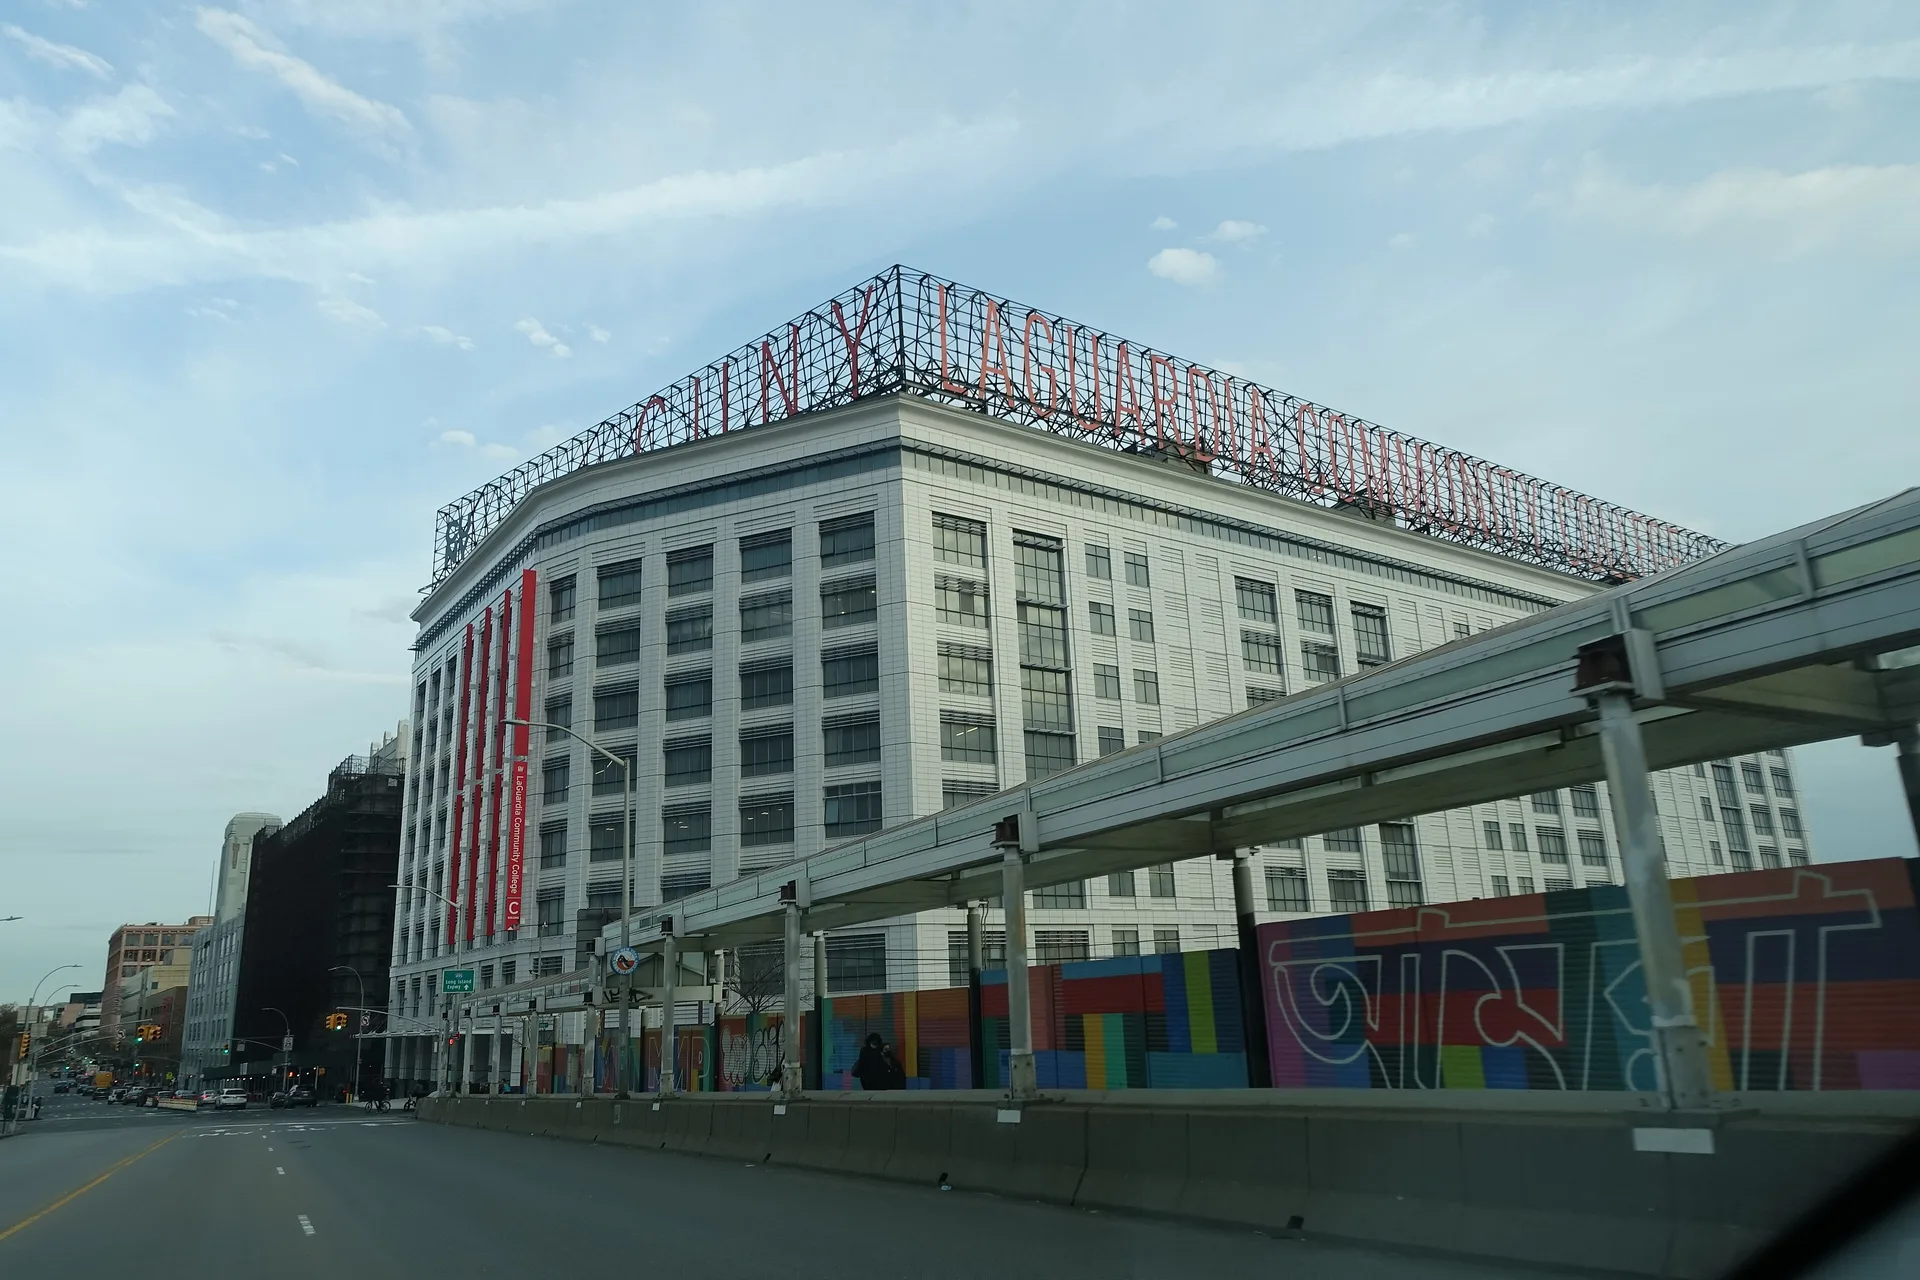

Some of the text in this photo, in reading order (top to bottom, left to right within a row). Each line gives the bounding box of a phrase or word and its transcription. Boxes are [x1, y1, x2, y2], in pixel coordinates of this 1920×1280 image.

[636, 284, 874, 455] CUNY
[937, 284, 1279, 482] LAGUARDIA
[1297, 402, 1543, 556] COMMUNITY
[514, 775, 525, 816] LaGuardia
[511, 817, 523, 862] Community
[509, 863, 521, 895] College
[508, 901, 519, 915] C
